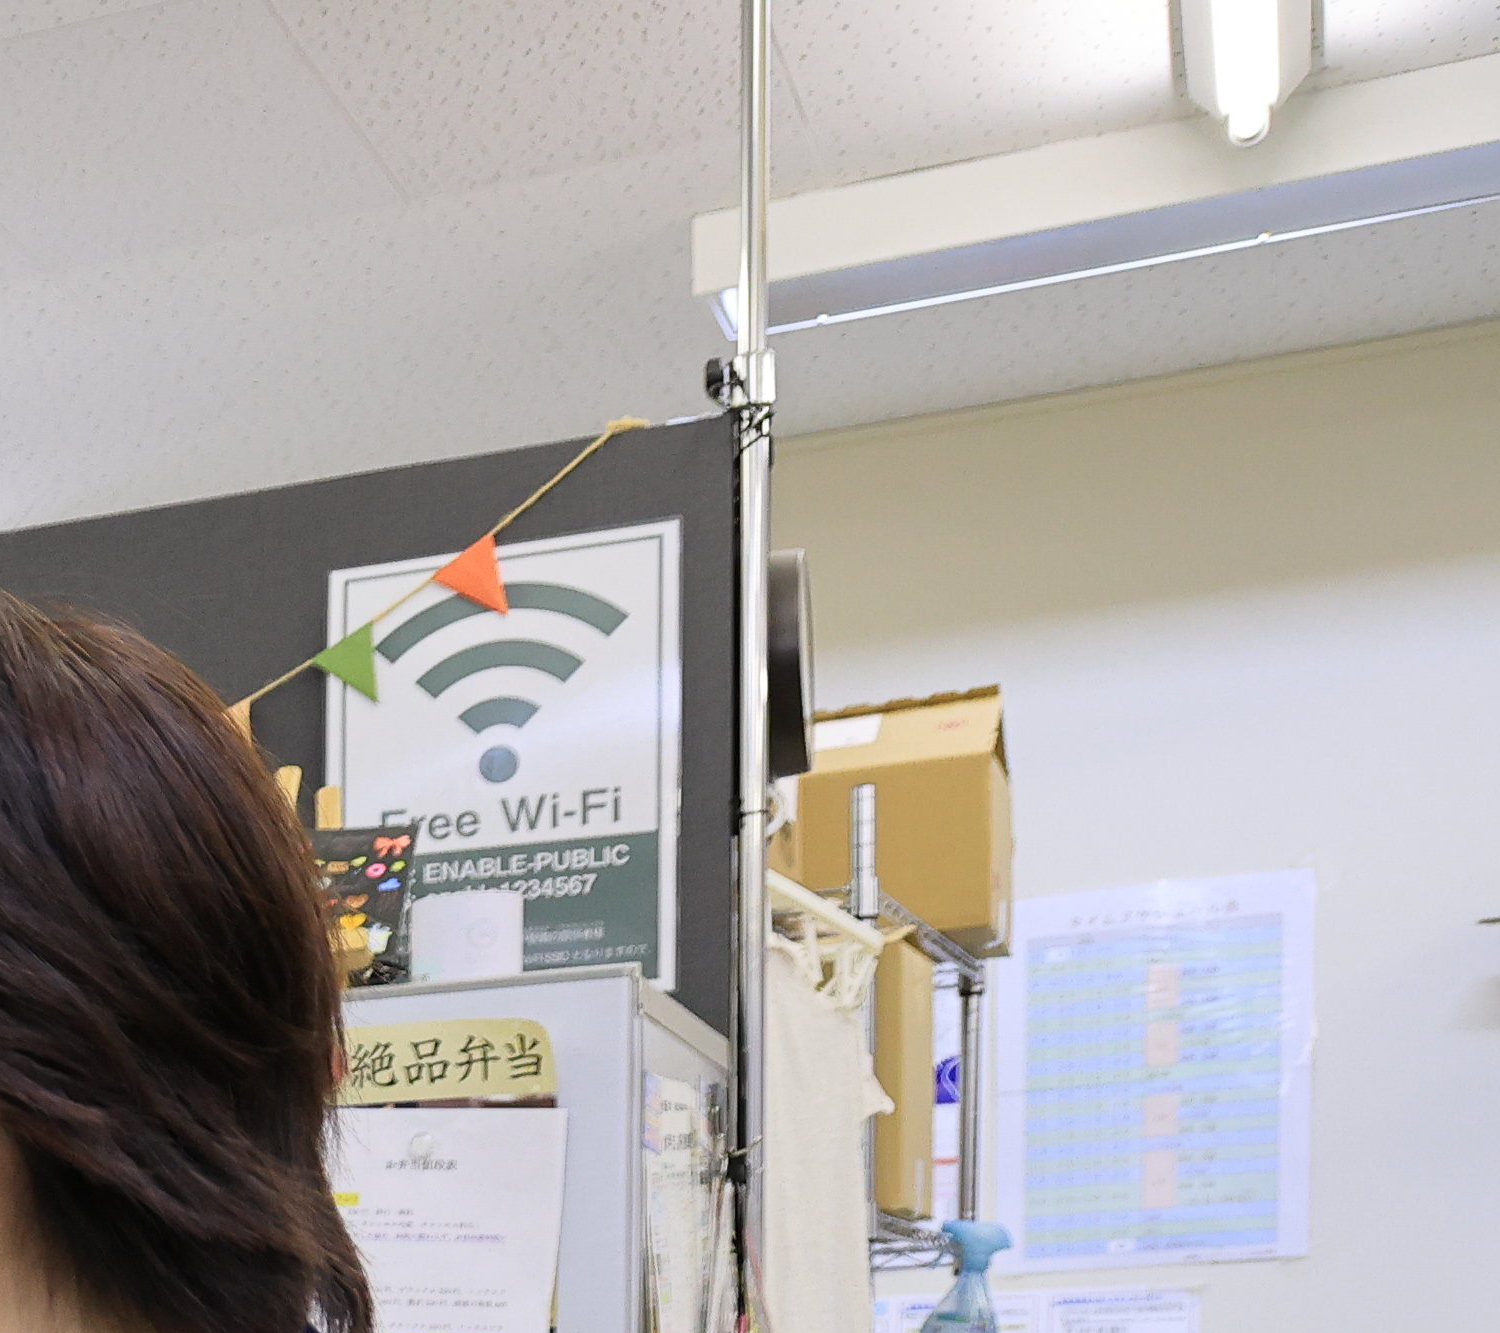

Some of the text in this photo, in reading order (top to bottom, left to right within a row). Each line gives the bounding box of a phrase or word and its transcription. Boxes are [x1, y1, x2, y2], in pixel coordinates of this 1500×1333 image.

[501, 786, 622, 833] Wi-Fi
[421, 843, 632, 885] ENABLE-PUBLIC
[350, 1033, 544, 1088] 絶品弁当
